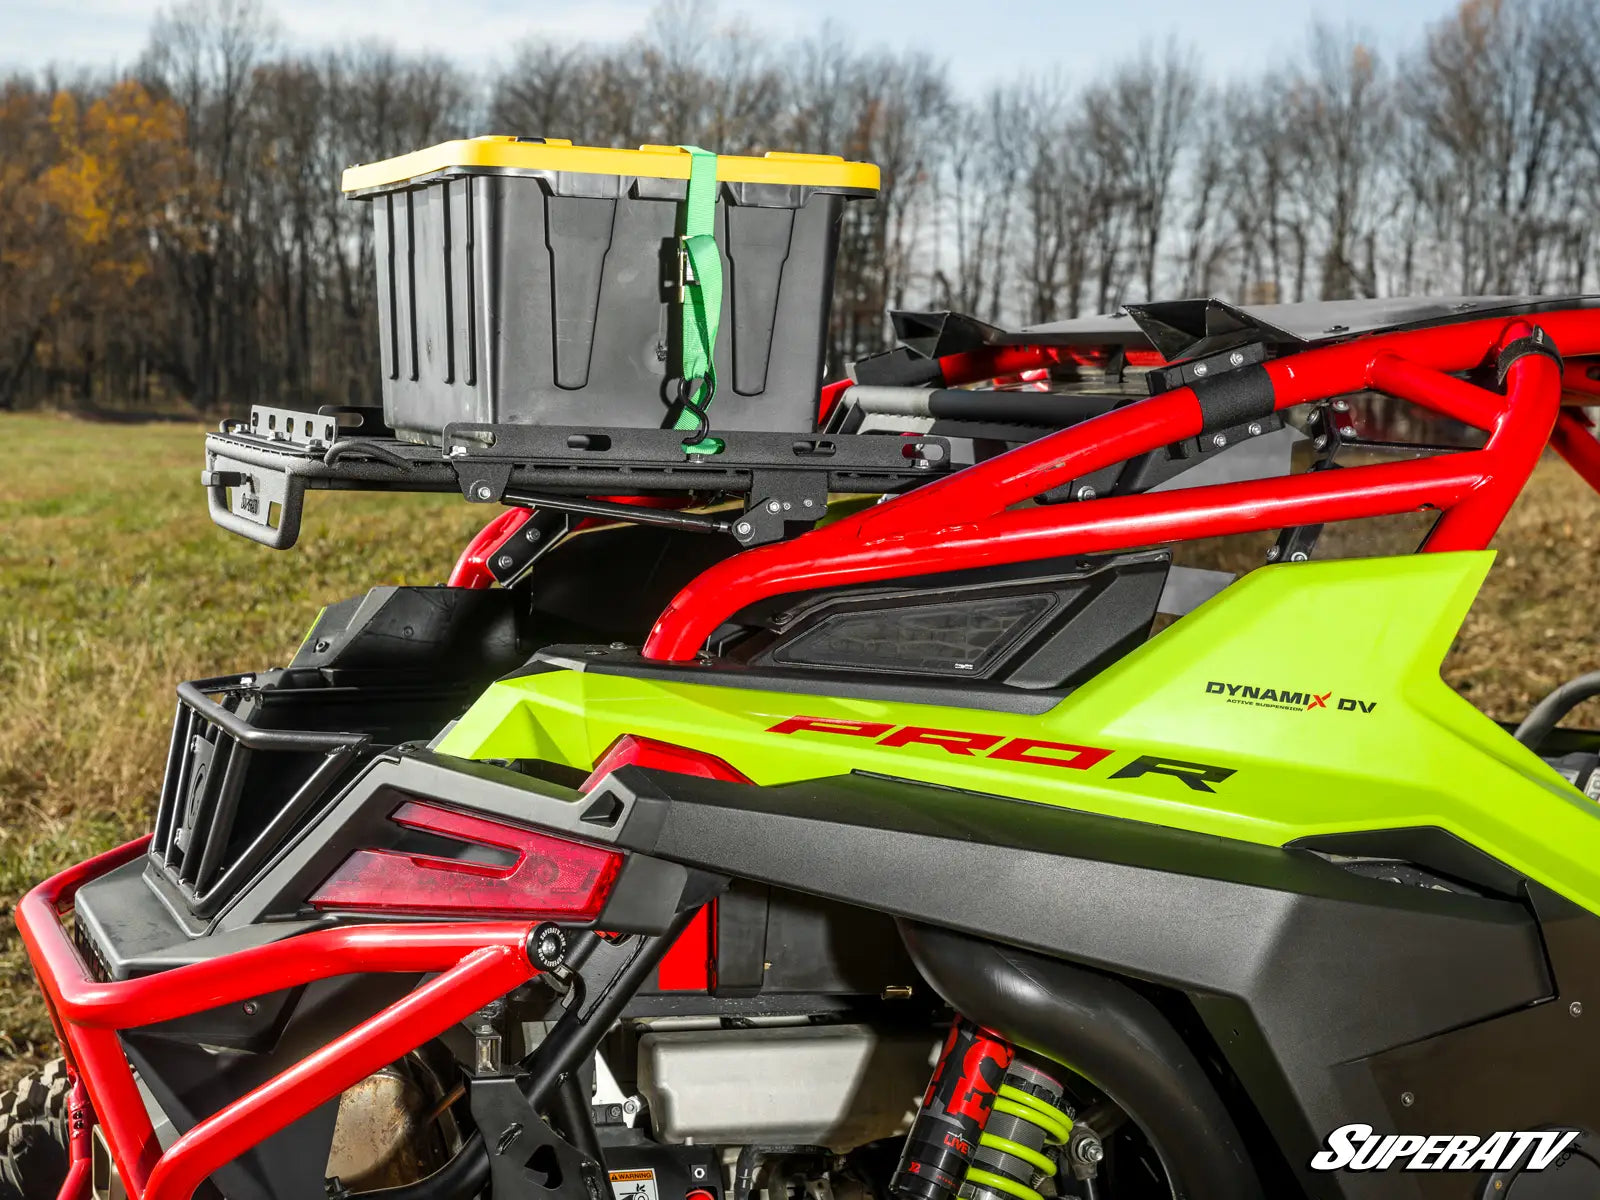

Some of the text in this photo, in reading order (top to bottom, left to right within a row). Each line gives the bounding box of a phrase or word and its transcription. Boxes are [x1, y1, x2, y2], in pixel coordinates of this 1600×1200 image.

[1205, 681, 1377, 713] DYNAMIX DV
[1226, 698, 1303, 712] ACTIVE SUSPENSION
[764, 715, 1238, 794] PRO R
